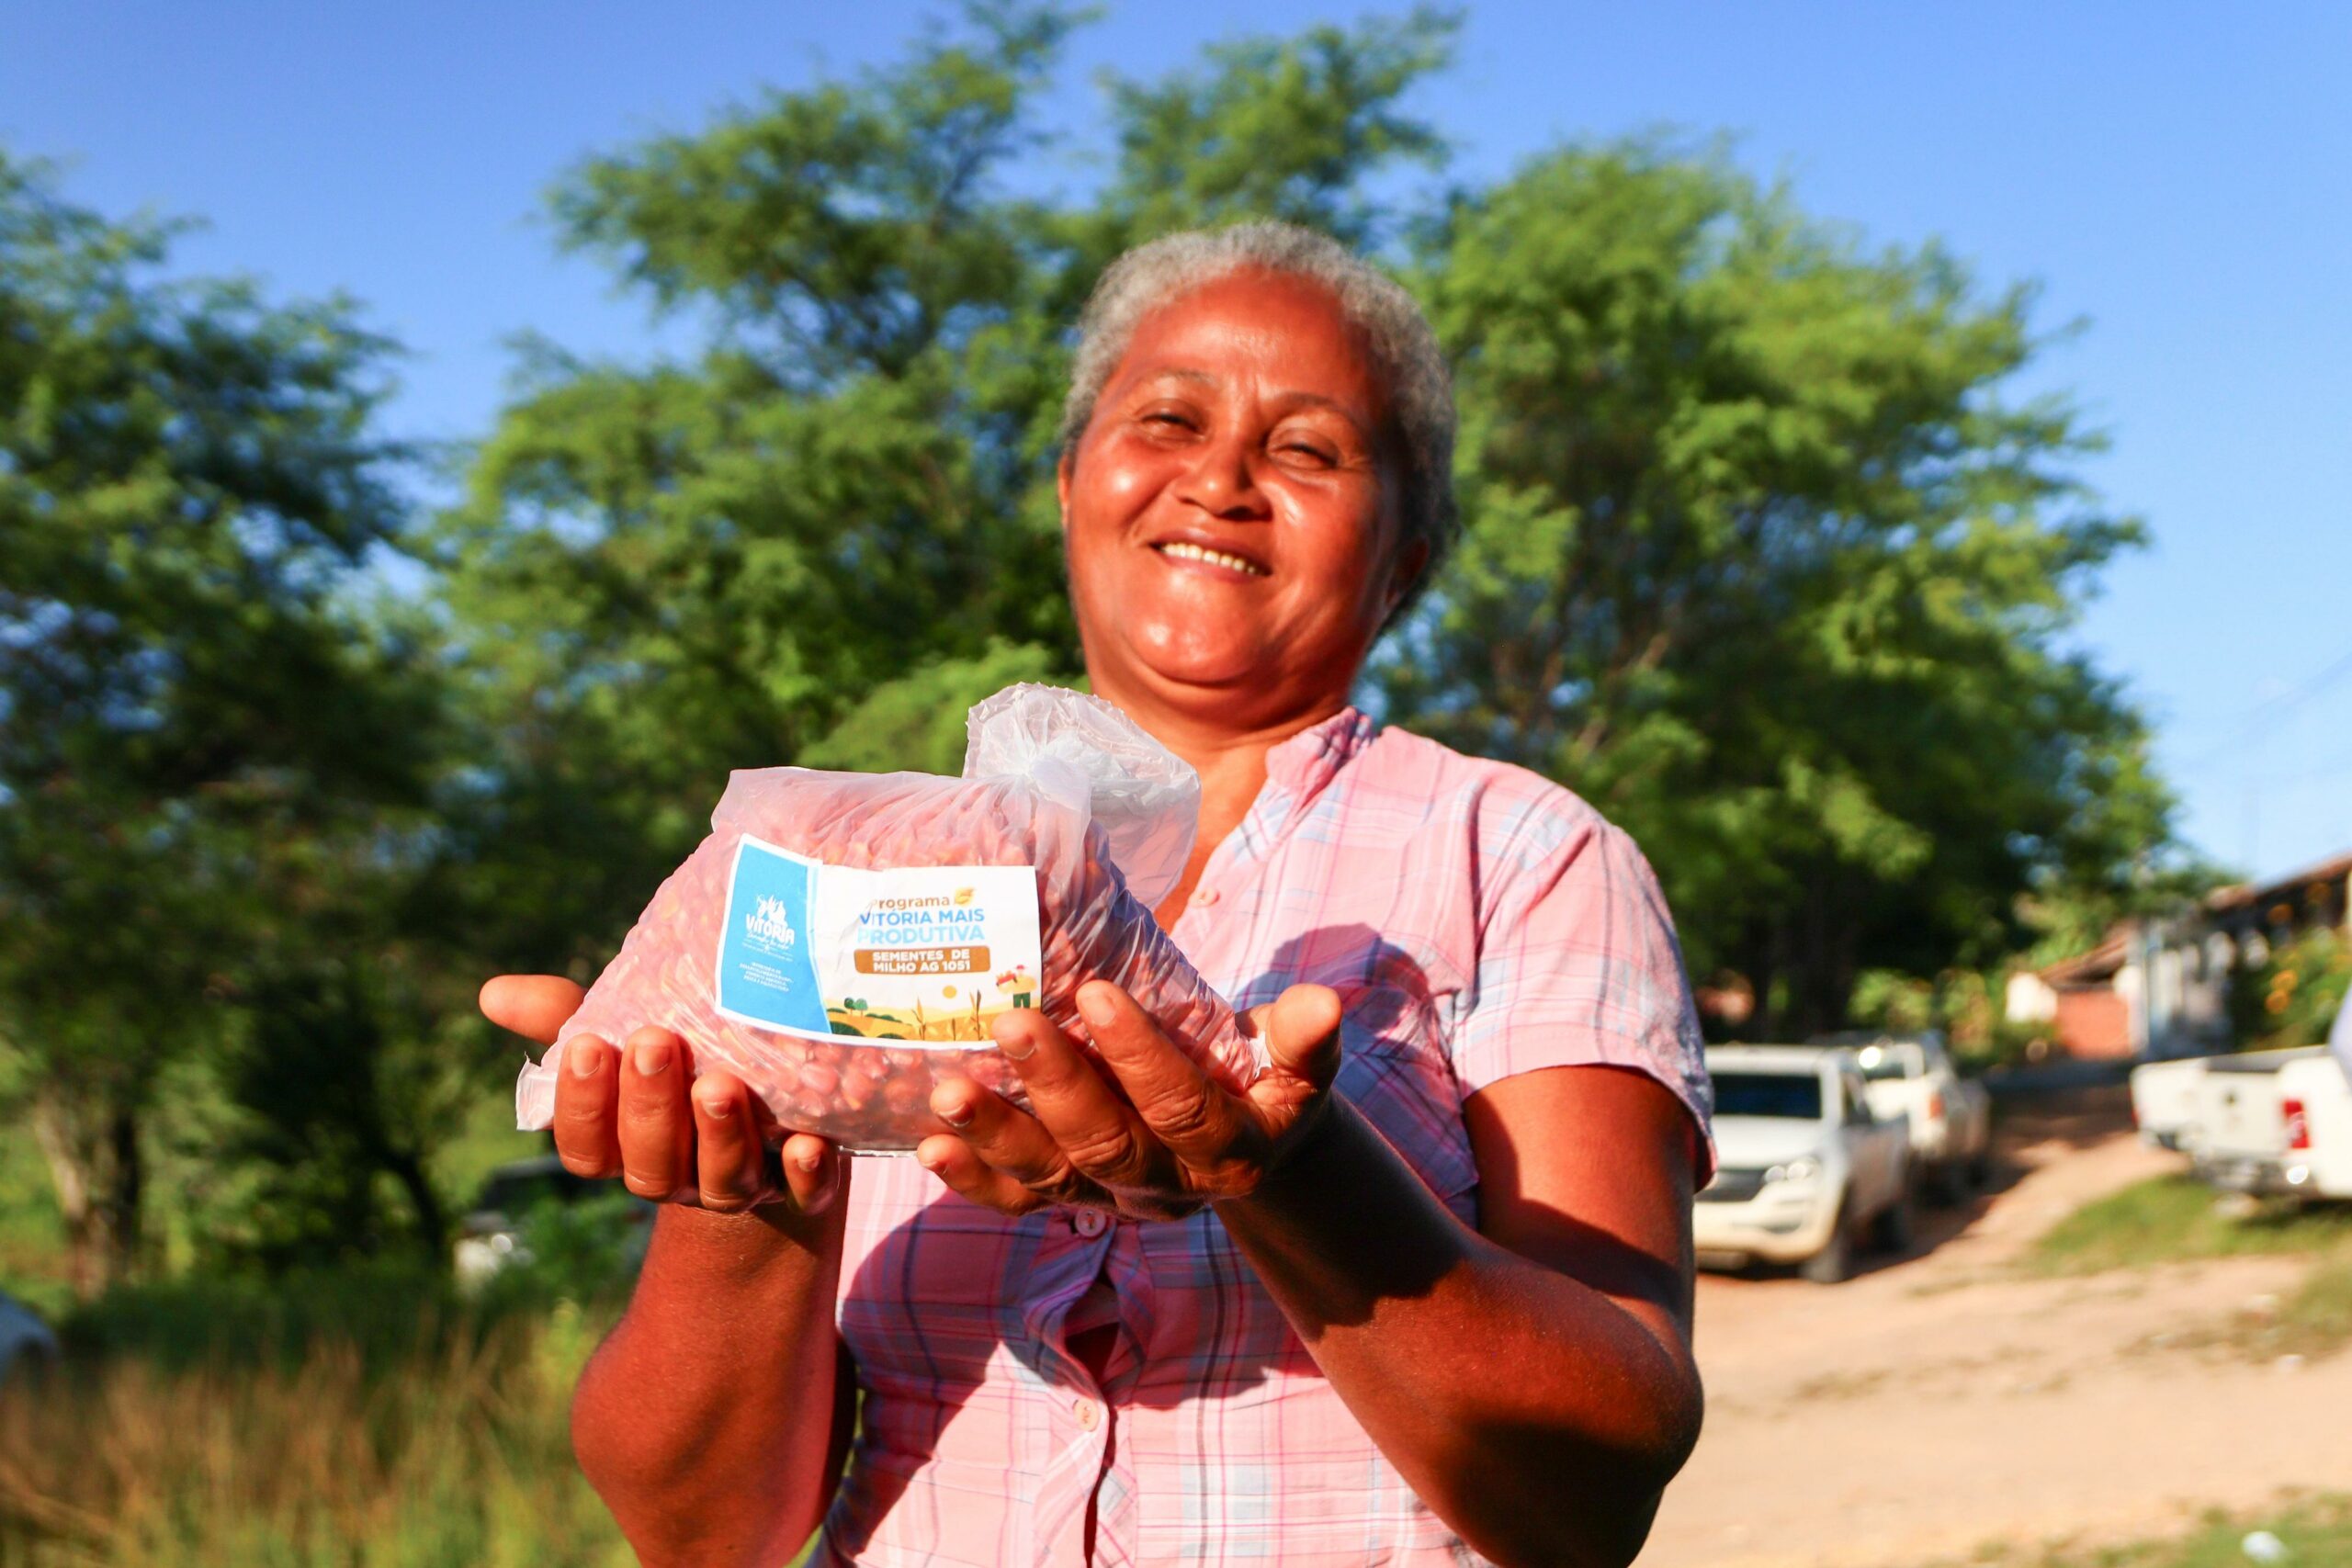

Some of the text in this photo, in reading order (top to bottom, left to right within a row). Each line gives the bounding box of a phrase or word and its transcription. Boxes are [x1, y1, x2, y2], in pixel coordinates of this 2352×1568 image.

[860, 908, 985, 926] VITÓRIA MAIS
[857, 924, 985, 944] PRODUTIVA
[873, 949, 970, 962] SEMENTES DE
[873, 959, 970, 973] MILHO AG 1051
